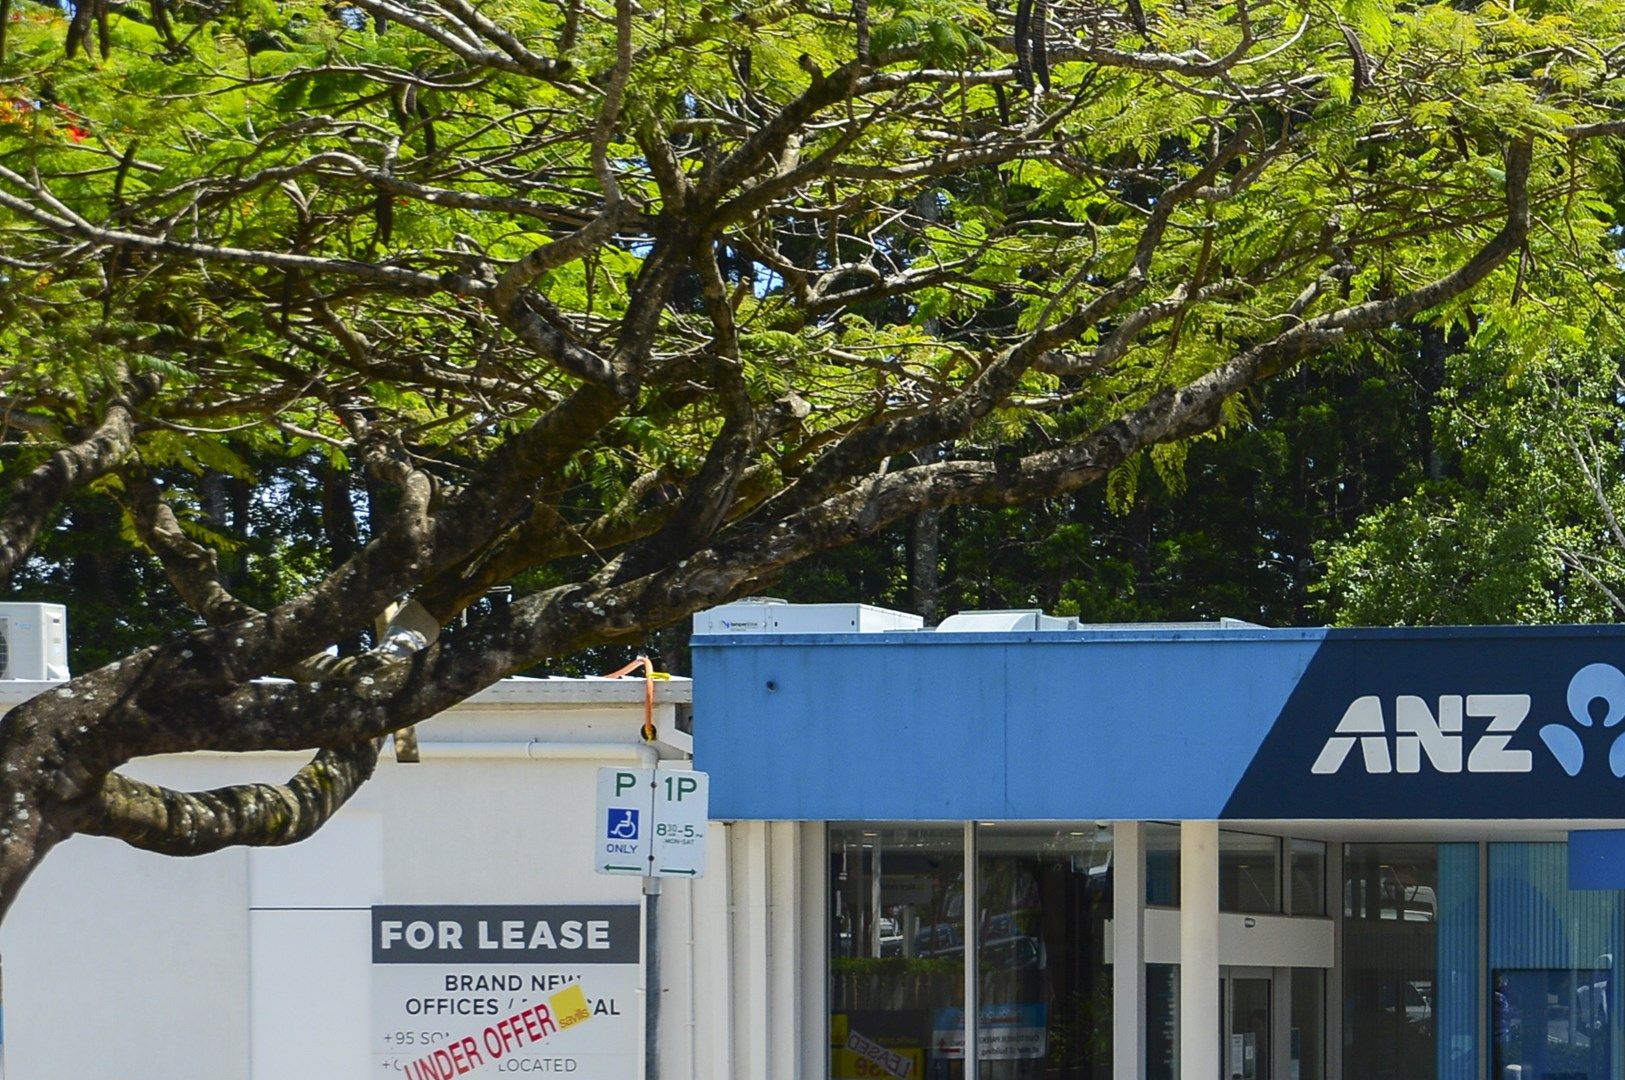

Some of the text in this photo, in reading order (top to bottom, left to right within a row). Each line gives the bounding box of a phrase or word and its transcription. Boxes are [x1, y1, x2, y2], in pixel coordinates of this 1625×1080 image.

[1310, 694, 1533, 774] ANZ
[616, 772, 637, 797] P
[664, 776, 697, 802] 1P
[606, 843, 638, 854] ONLY
[381, 920, 611, 949] FOR LEASE
[445, 975, 523, 991] BRAND
[406, 998, 499, 1015] OFFICES
[483, 1003, 557, 1059] OFFER
